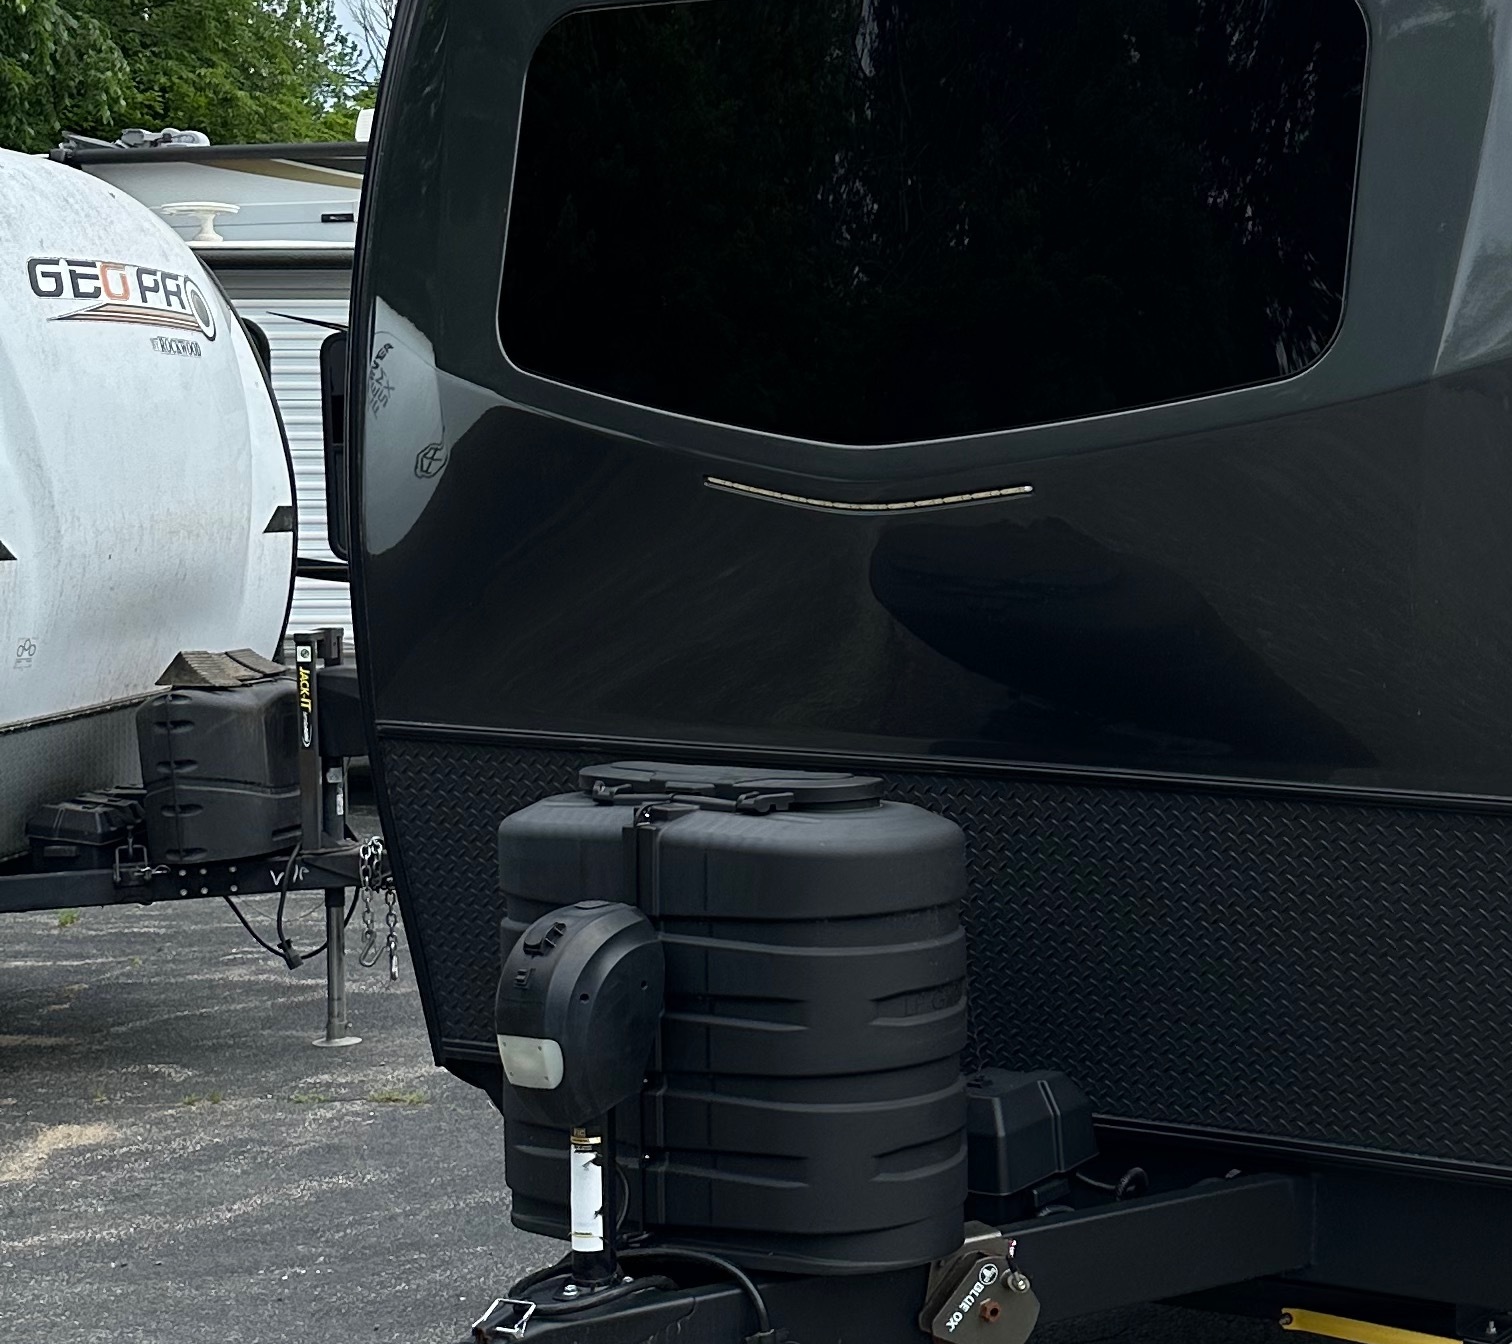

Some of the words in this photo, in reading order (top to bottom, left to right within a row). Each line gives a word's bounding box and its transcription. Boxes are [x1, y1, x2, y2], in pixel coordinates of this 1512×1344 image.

[299, 665, 312, 714] JACK-IT
[959, 1281, 985, 1312] BLUE
[945, 1311, 963, 1332] OX
